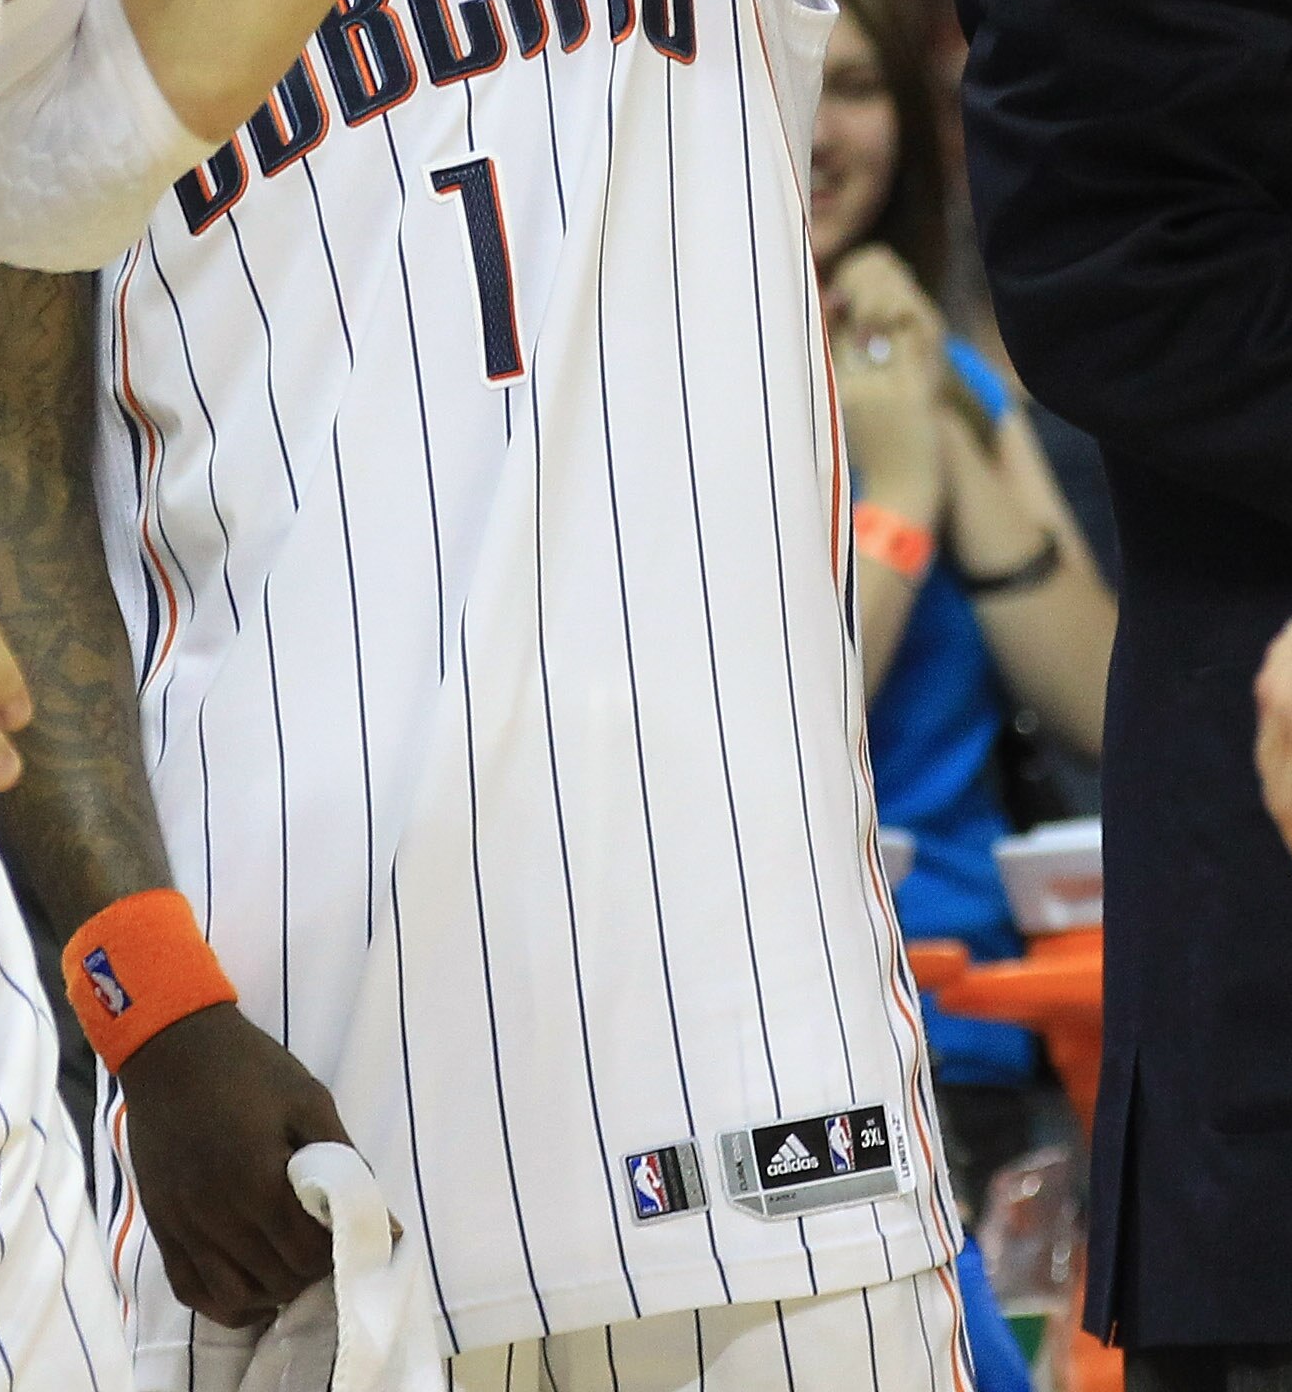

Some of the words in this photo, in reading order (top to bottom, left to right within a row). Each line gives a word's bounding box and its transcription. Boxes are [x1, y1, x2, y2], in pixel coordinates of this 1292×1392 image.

[427, 154, 527, 384] 1
[860, 1127, 886, 1149] 3XL
[766, 1156, 820, 1178] adidas
